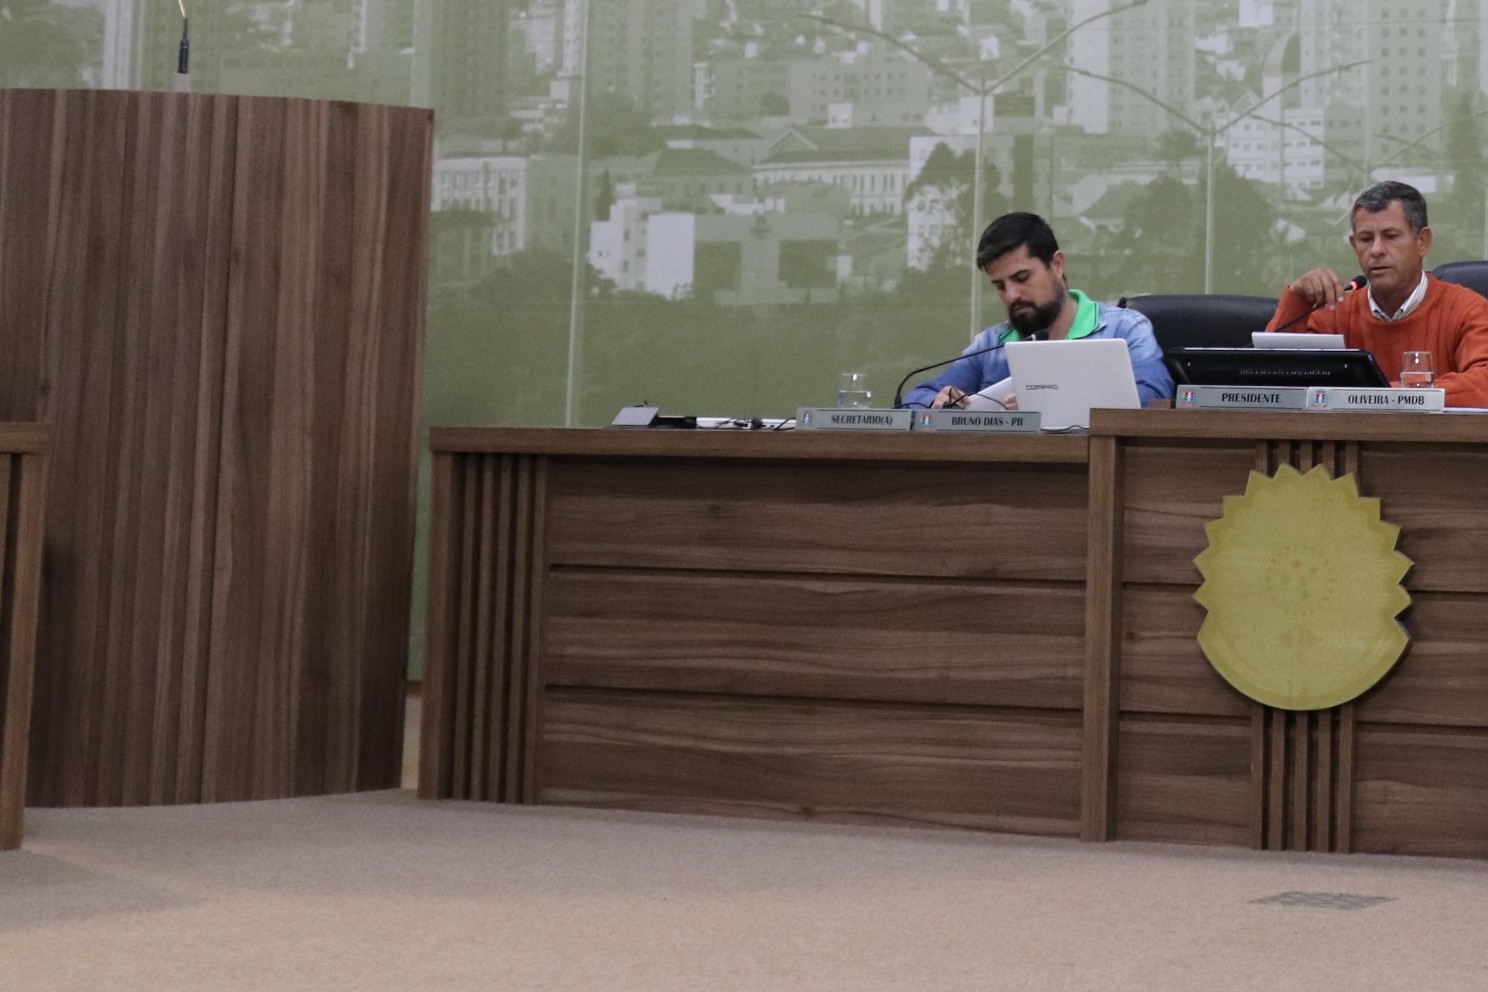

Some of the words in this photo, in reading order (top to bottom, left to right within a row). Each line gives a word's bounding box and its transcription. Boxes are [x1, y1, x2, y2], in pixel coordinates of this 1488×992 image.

[1222, 393, 1281, 404] PRESIDENTE
[1348, 394, 1389, 405] OLIVEIRA
[1398, 395, 1424, 406] PMDB
[952, 416, 980, 427] BRUNO
[984, 417, 1003, 427] DIAS
[1010, 417, 1023, 427] PR
